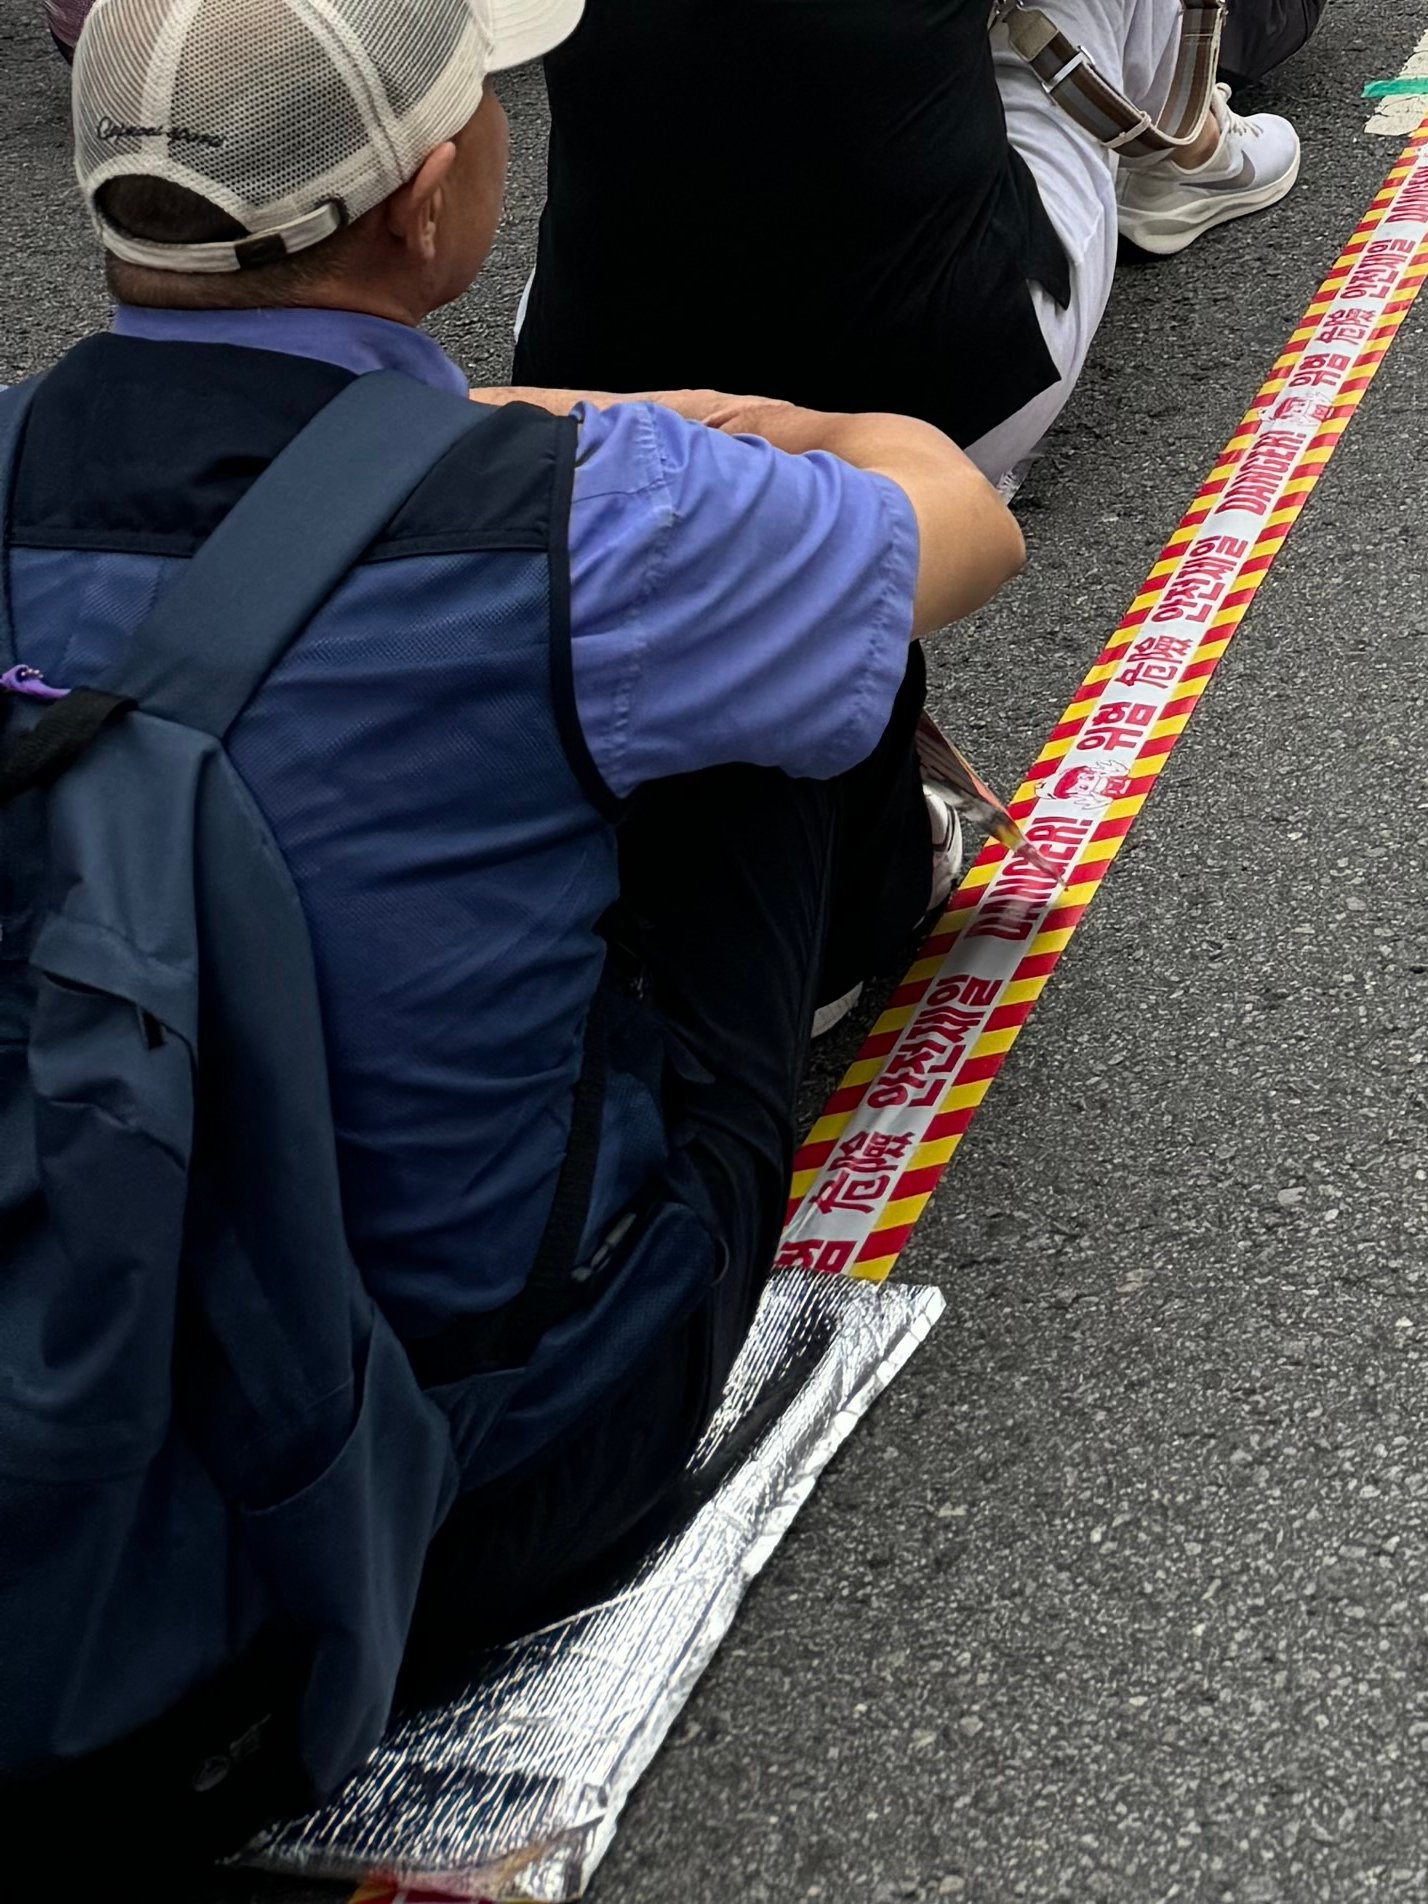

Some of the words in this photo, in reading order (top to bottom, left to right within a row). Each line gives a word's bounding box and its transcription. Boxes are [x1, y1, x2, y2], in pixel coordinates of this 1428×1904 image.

[1339, 239, 1416, 299] 안전제일
[1289, 353, 1351, 388] 위험
[1215, 430, 1308, 516] DANGER!
[1151, 535, 1249, 624] 안전제일
[1076, 701, 1157, 752] 위험
[867, 974, 1005, 1110] 안전제일
